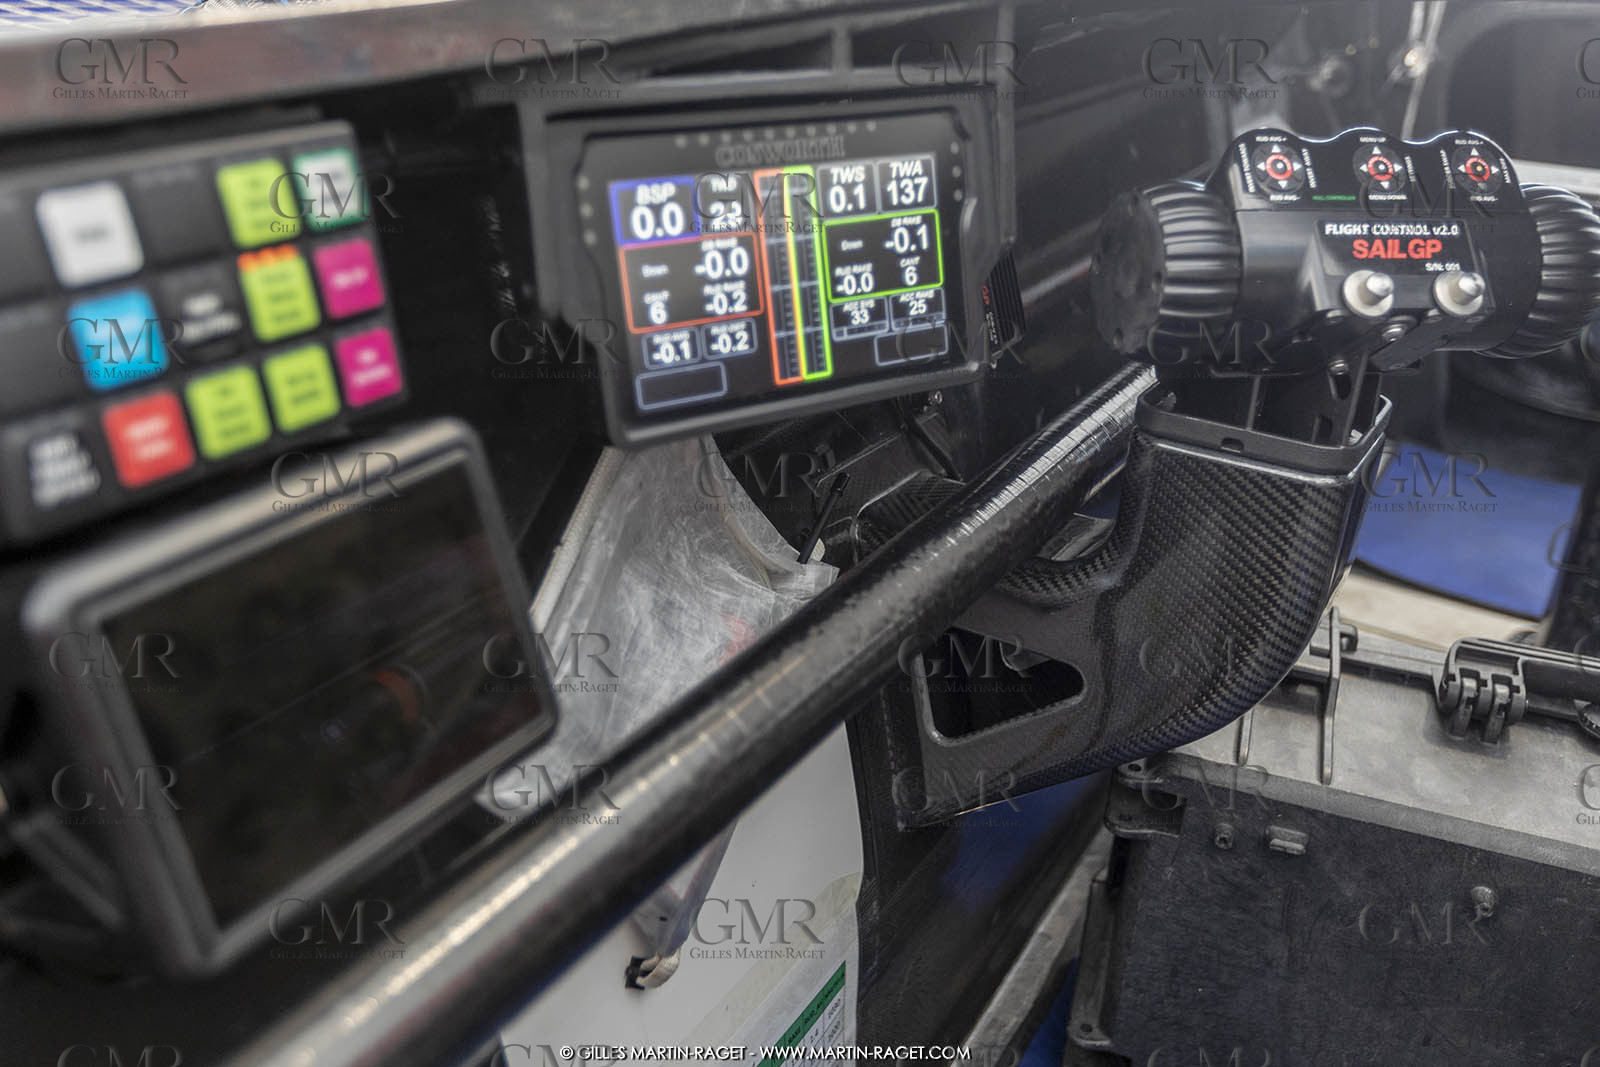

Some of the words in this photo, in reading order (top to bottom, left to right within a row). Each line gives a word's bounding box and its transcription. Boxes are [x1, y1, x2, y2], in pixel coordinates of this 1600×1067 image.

[830, 166, 866, 185] TWS
[889, 160, 923, 178] TWA
[636, 182, 676, 205] BSP
[829, 183, 867, 213] 0.1
[887, 176, 928, 206] 137
[630, 201, 685, 240] 0.0
[1325, 224, 1370, 235] FLIGHT
[1371, 224, 1430, 235] CONTROL
[1432, 224, 1459, 235] v2.0
[885, 224, 928, 253] -0.1
[694, 246, 749, 279] -0.0
[836, 272, 874, 295] -0.0
[904, 266, 918, 286] 6
[649, 301, 667, 324] 6
[705, 291, 748, 315] -0.2
[909, 301, 927, 315] 25
[851, 310, 869, 325] 33
[652, 340, 691, 364] -0.1
[711, 331, 749, 354] -0.2
